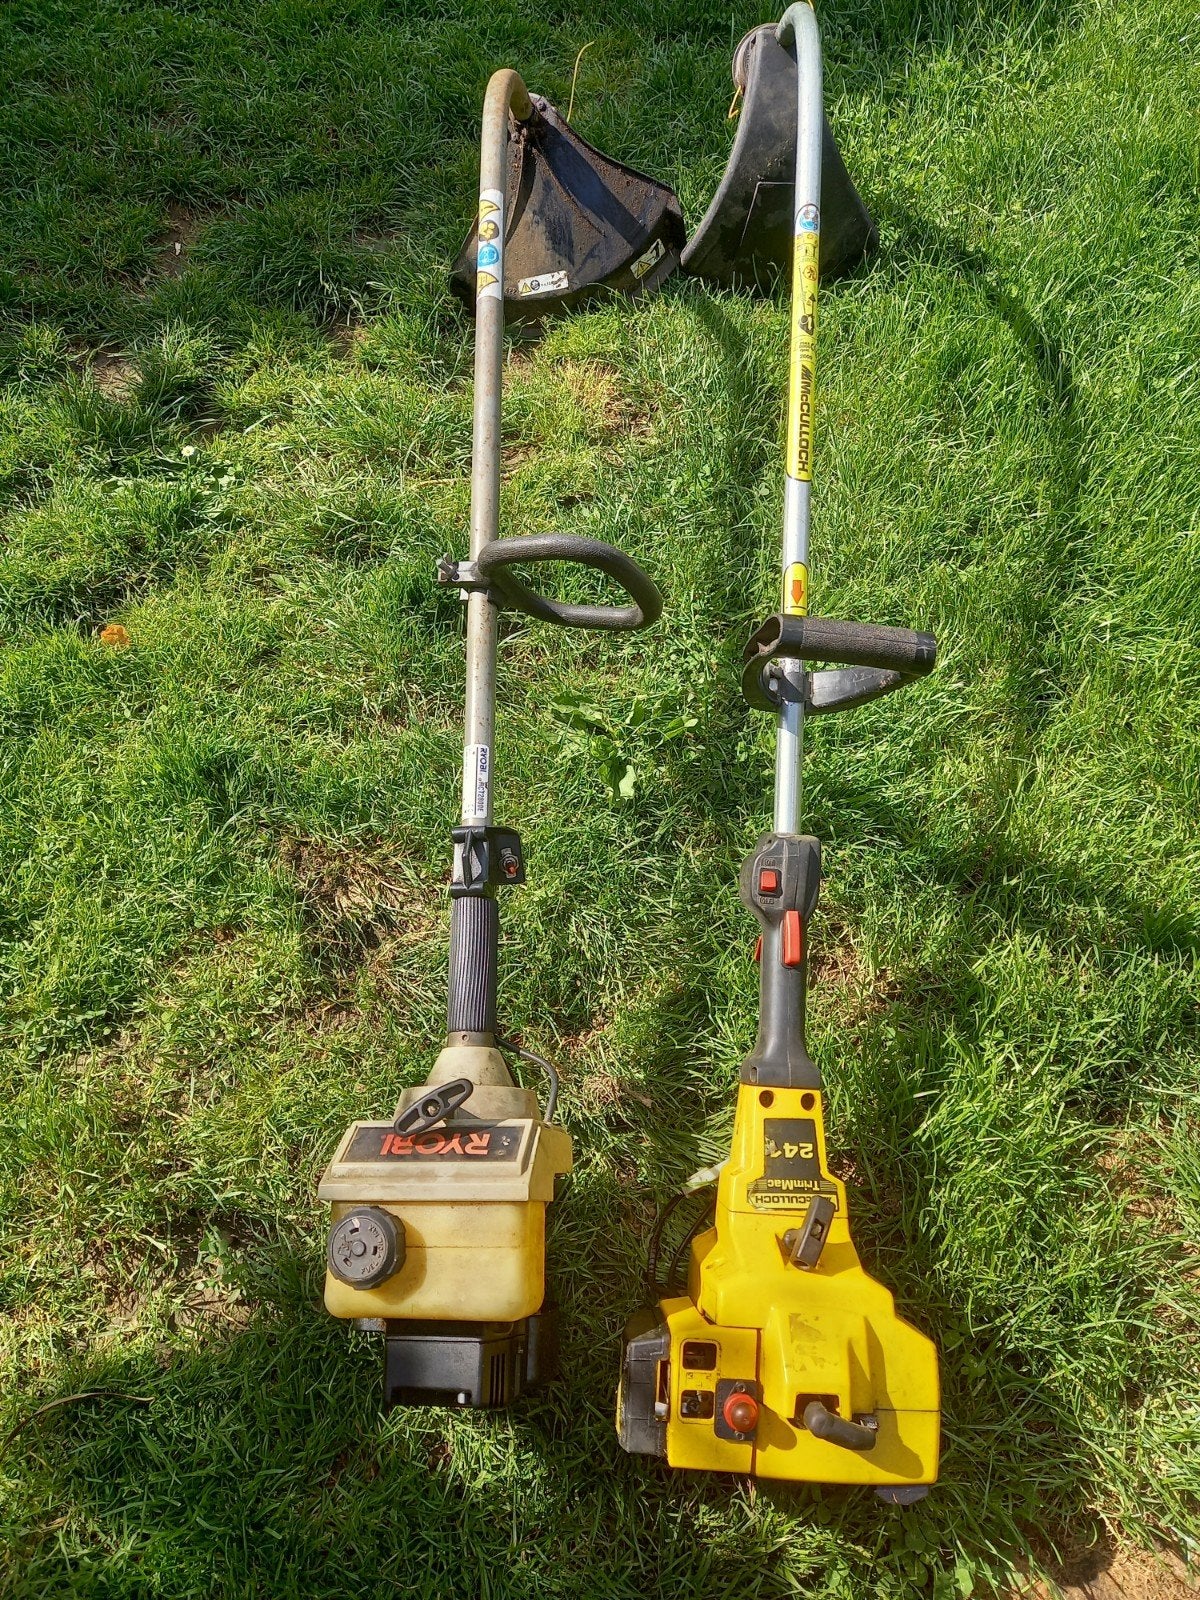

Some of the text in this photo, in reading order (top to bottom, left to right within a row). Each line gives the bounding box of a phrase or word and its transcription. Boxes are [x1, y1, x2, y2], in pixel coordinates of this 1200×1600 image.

[798, 380, 812, 473] McCULLOCH
[480, 746, 488, 773] RYOBI
[380, 1133, 491, 1155] RYOBI
[767, 1179, 820, 1192] TrimMac
[755, 1194, 811, 1204] cCULLOCH
